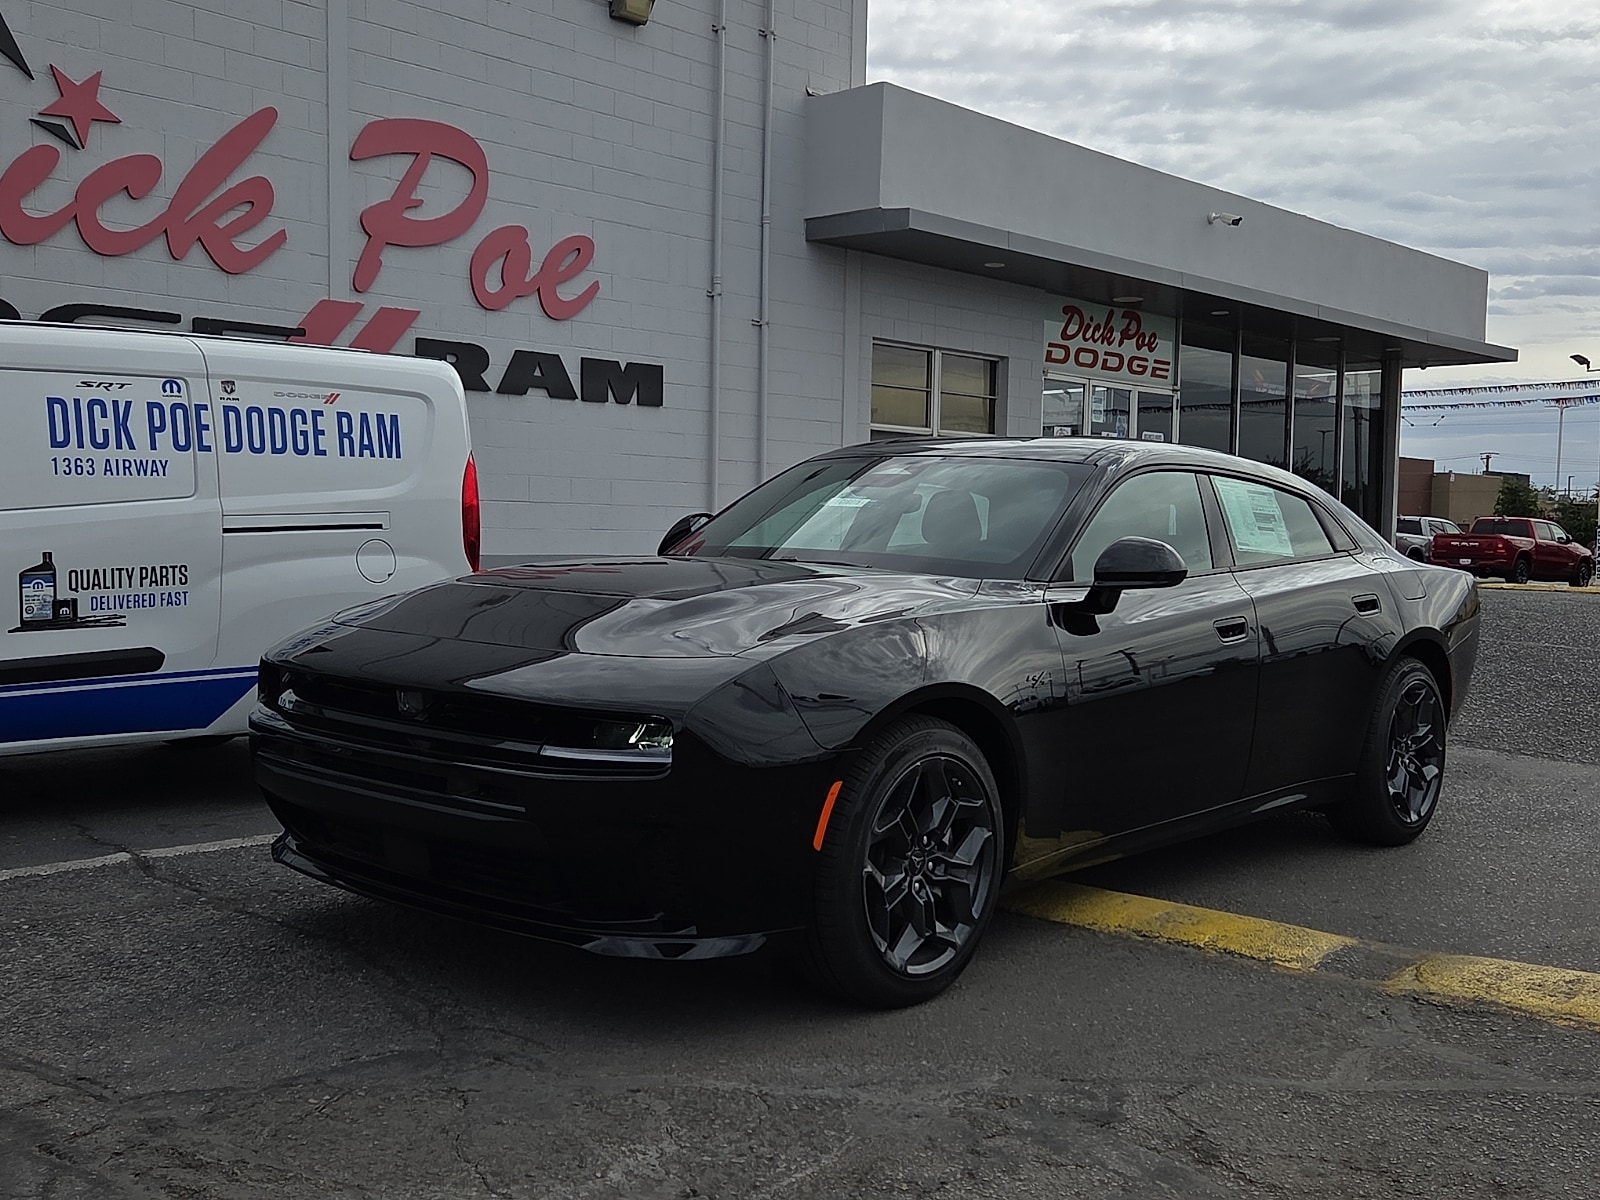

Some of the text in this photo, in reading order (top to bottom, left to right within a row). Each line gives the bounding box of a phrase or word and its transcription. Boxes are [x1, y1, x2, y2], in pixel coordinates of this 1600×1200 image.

[0, 106, 601, 321] ick Poe
[1060, 304, 1159, 353] Dick Poe
[414, 336, 664, 407] RAM
[1044, 342, 1171, 380] DODGE
[75, 380, 133, 392] SRT
[46, 396, 402, 460] DICK POE DODGE RAM
[51, 456, 169, 477] 1363 AIRWAY
[68, 564, 189, 594] QUALITY PARTS
[90, 591, 189, 612] DELIVERED FAST
